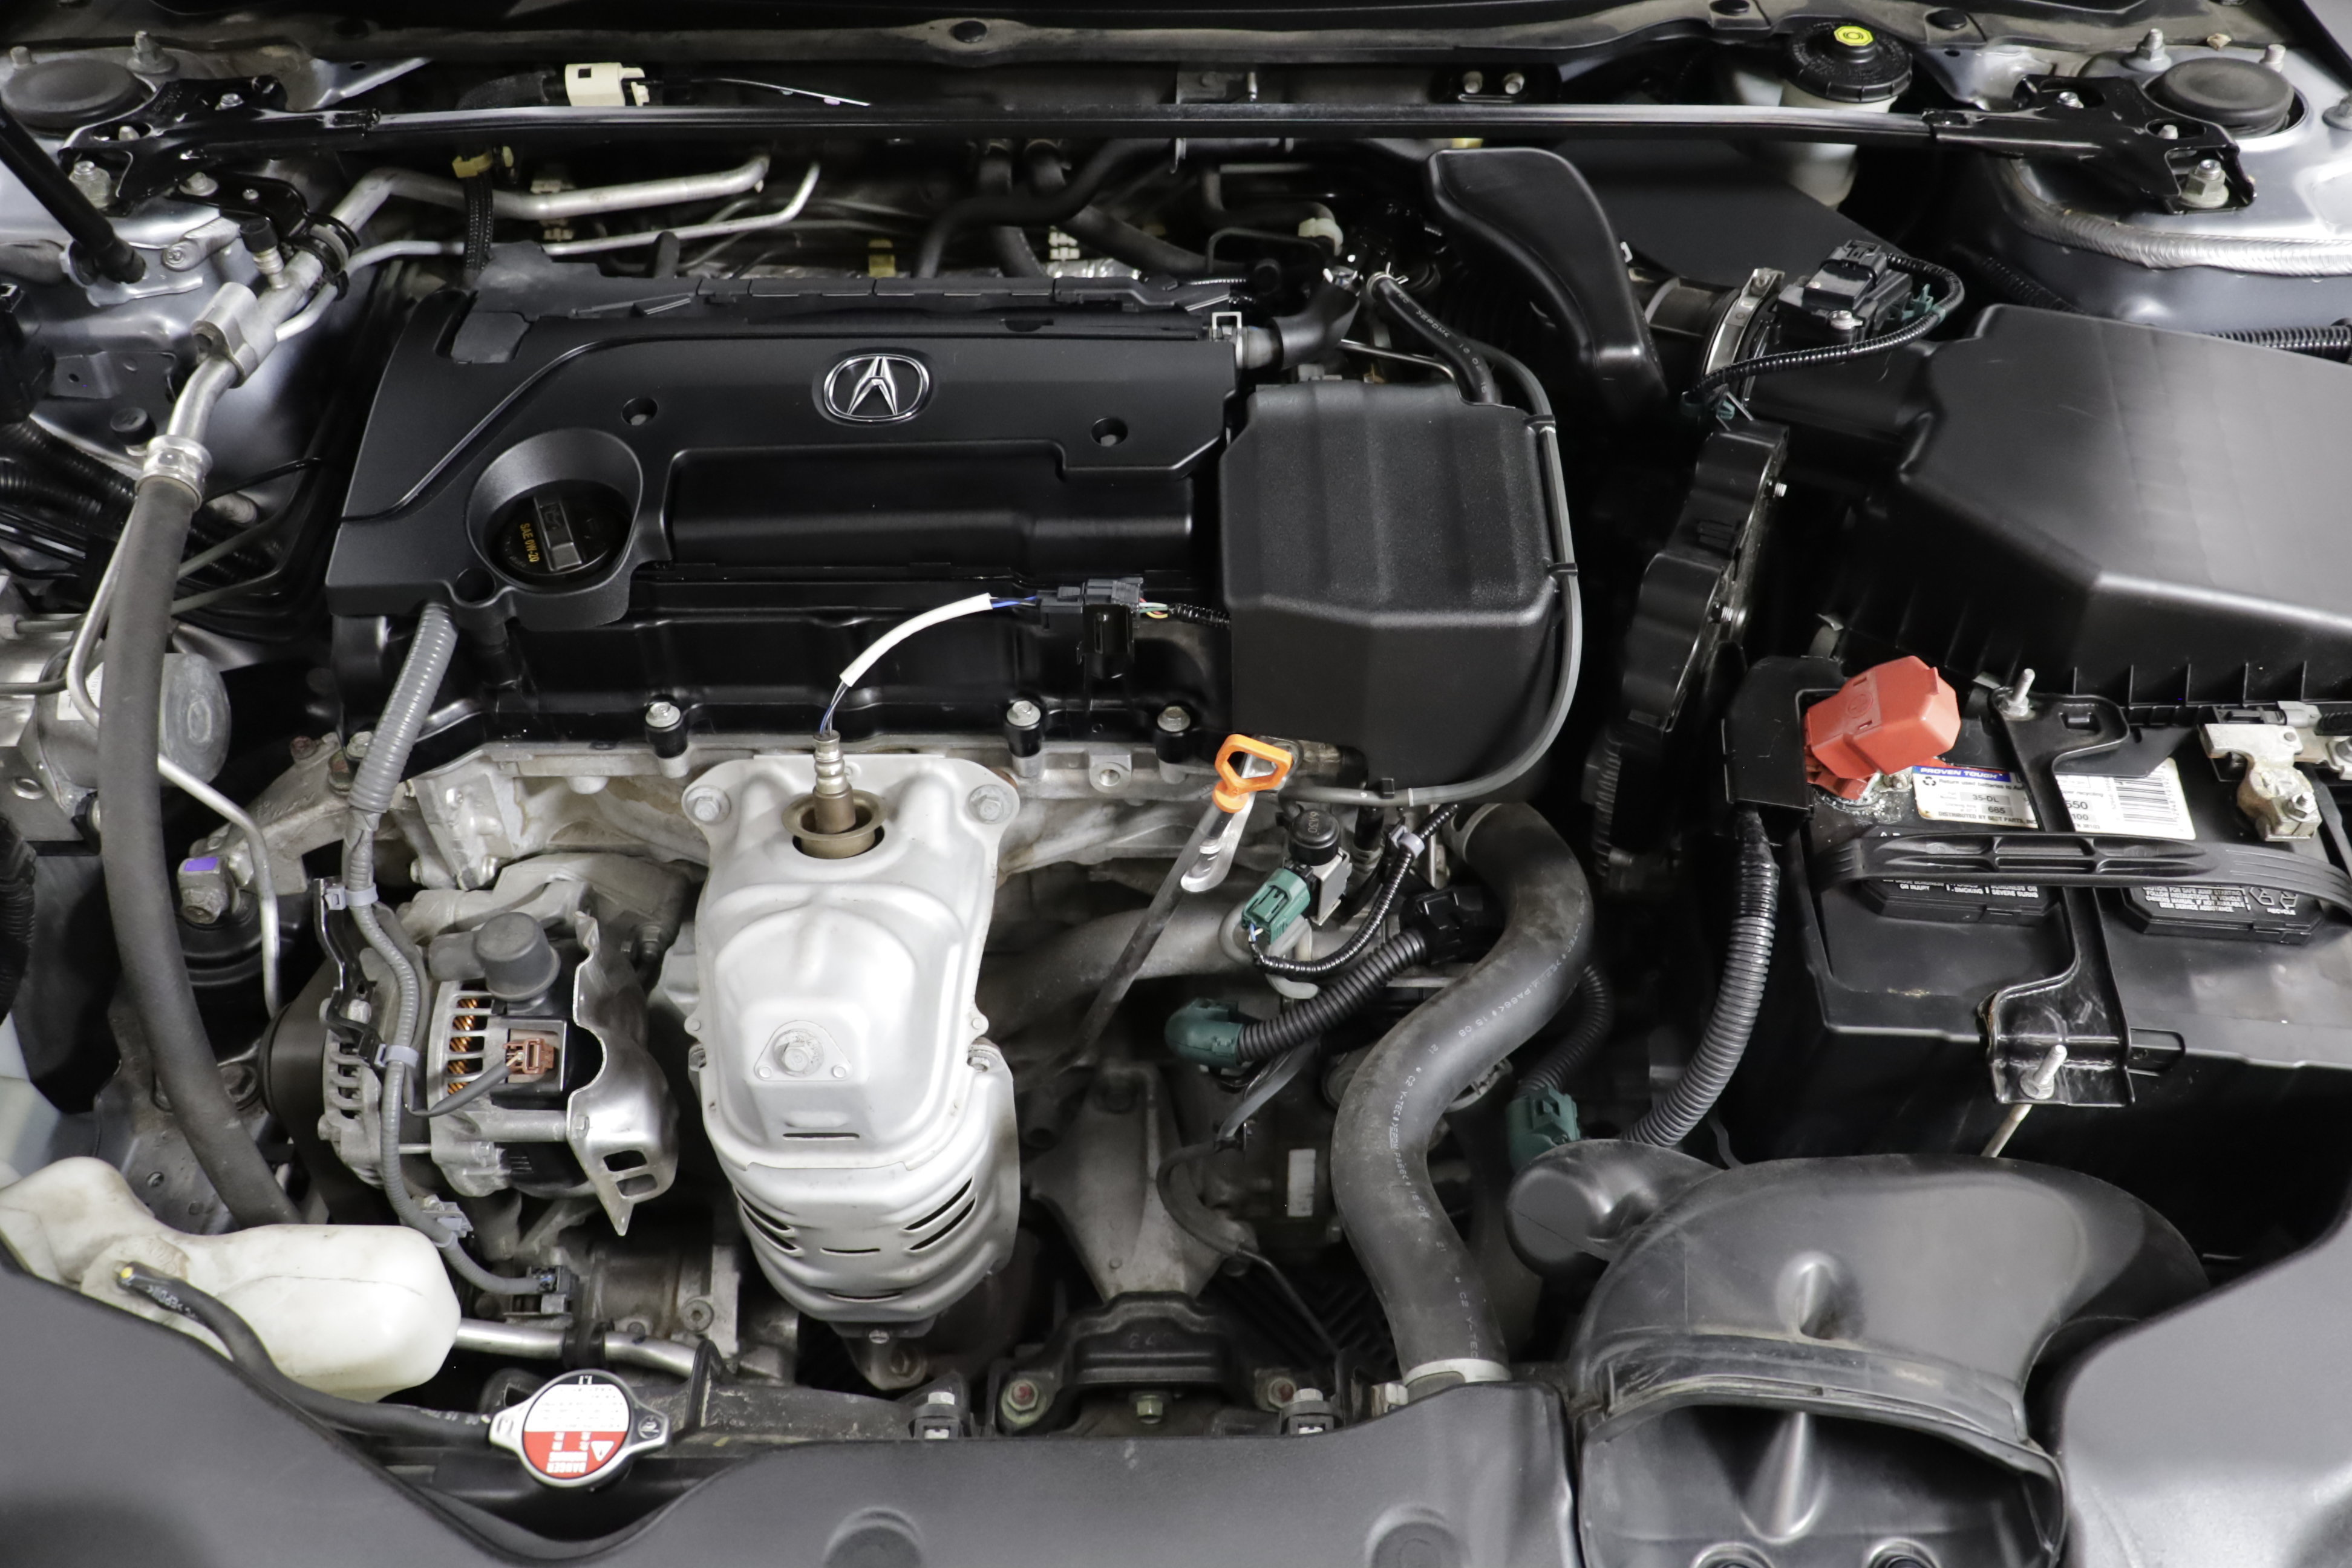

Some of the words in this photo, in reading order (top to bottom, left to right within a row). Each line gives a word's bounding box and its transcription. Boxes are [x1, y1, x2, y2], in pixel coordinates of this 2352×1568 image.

[520, 523, 533, 540] SAE
[524, 539, 540, 563] 0W-20
[1920, 767, 1961, 776] PROVEN
[1972, 794, 1999, 803] 35-DL
[1475, 1016, 1489, 1027] 15
[1459, 1025, 1472, 1037] 08
[1428, 1044, 1439, 1054] 21
[1405, 1076, 1416, 1086] C2
[1393, 1091, 1408, 1116] Y-TEC
[1410, 1190, 1420, 1201] 15
[1459, 1292, 1469, 1307] C2
[1466, 1316, 1480, 1359] Y-TEC
[546, 1462, 587, 1474] DANGER
